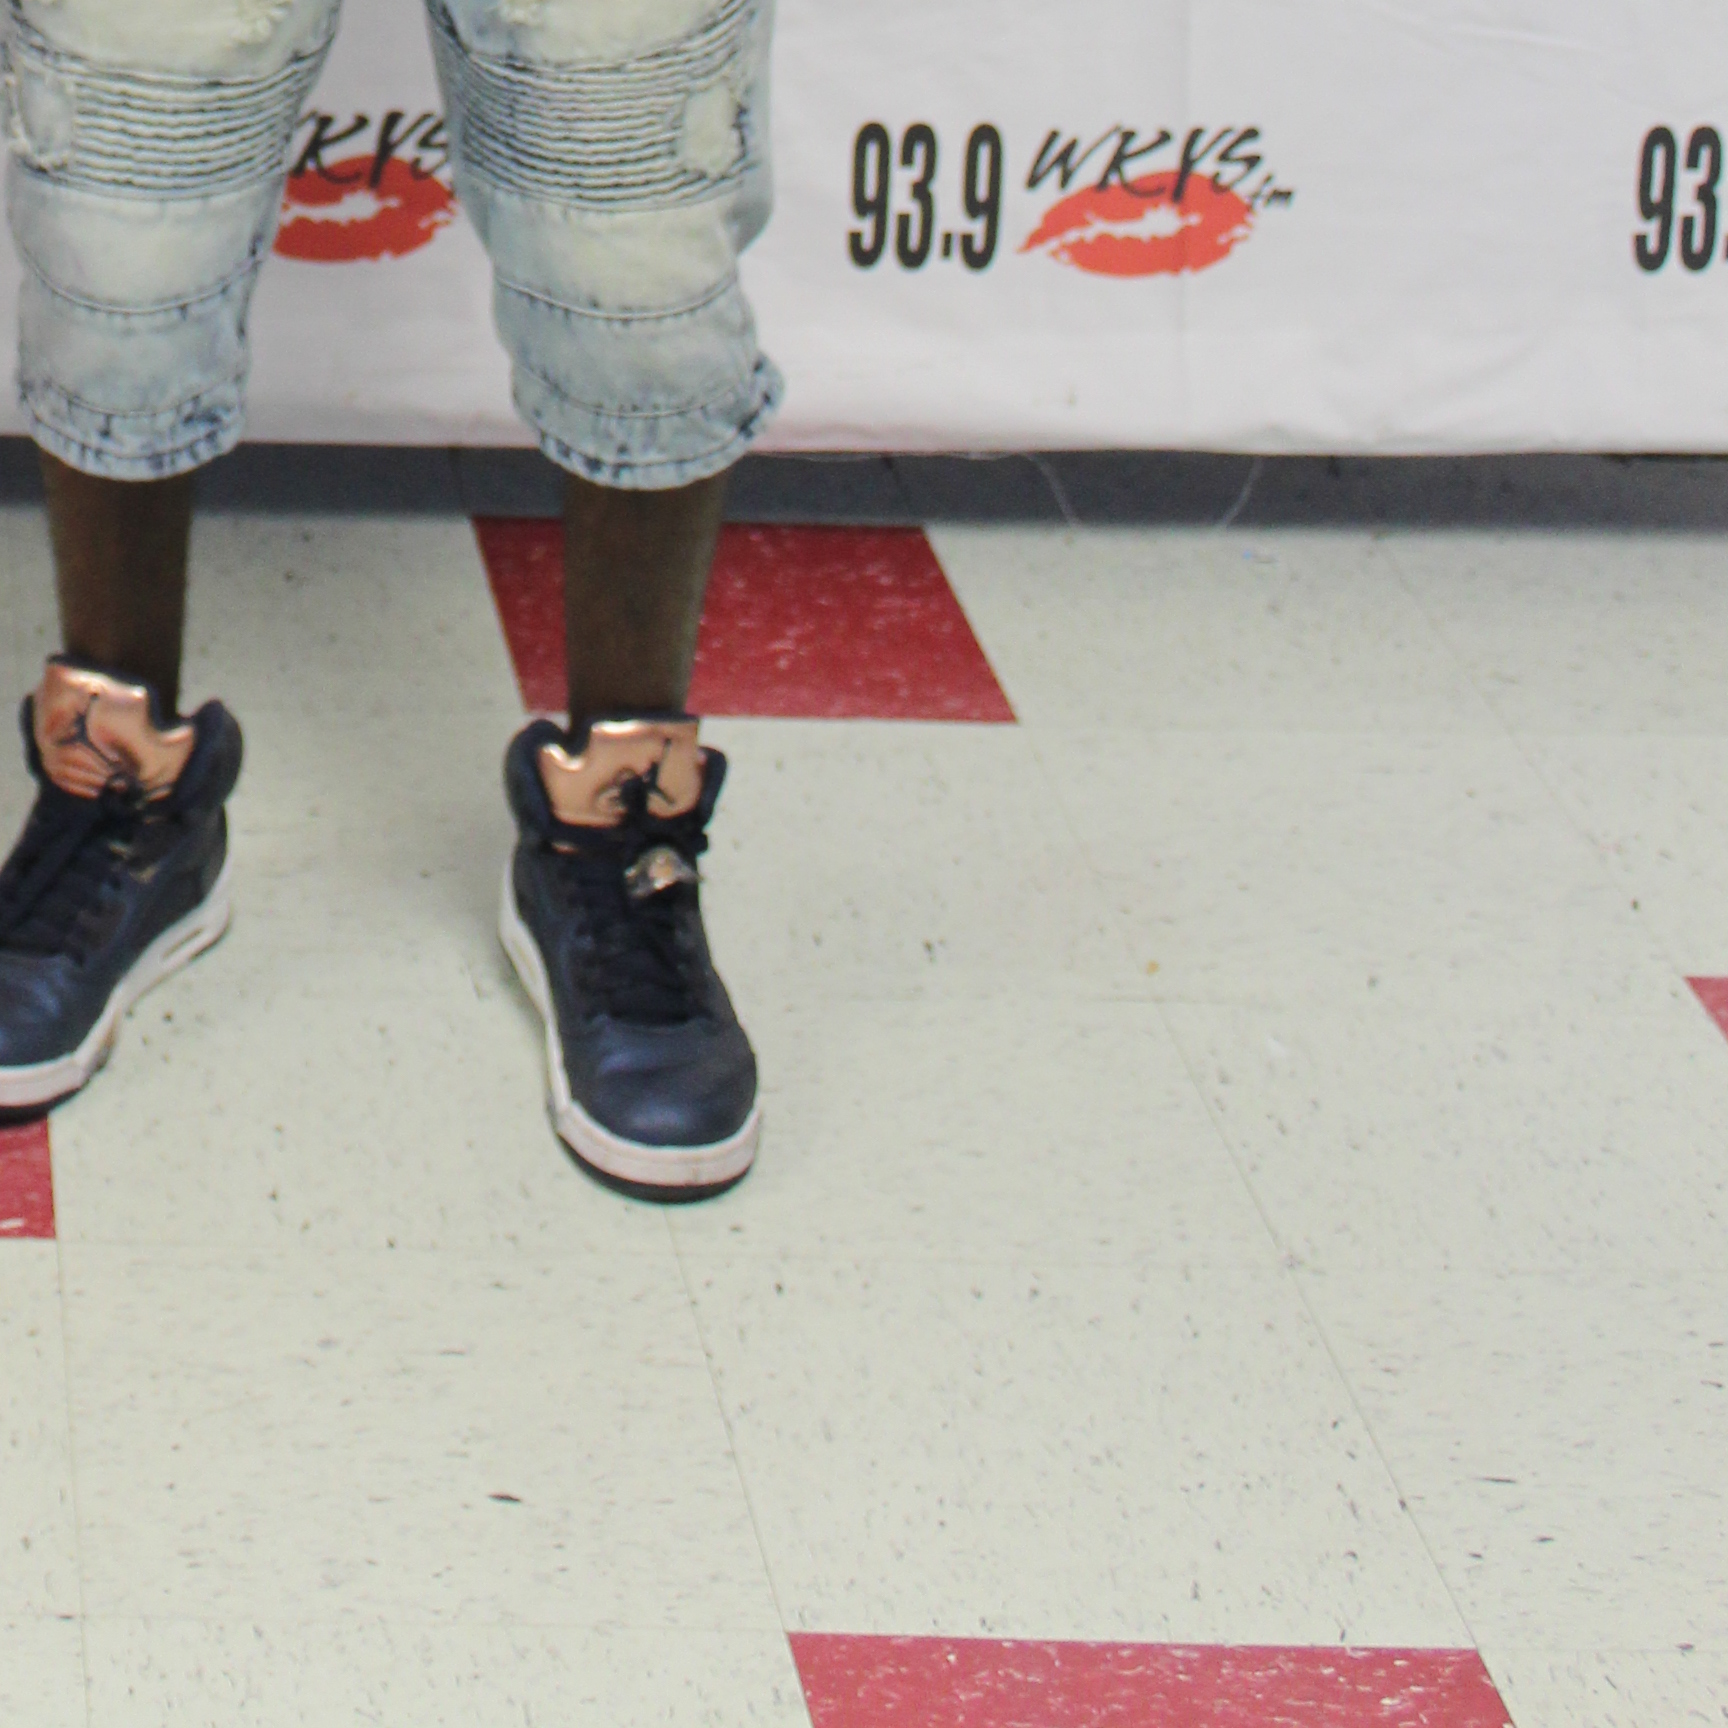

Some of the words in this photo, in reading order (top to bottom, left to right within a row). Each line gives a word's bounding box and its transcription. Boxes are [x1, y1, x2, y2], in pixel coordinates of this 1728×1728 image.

[288, 110, 448, 190] KYS
[849, 123, 1003, 272] 93.9
[1026, 126, 1263, 204] WKYS
